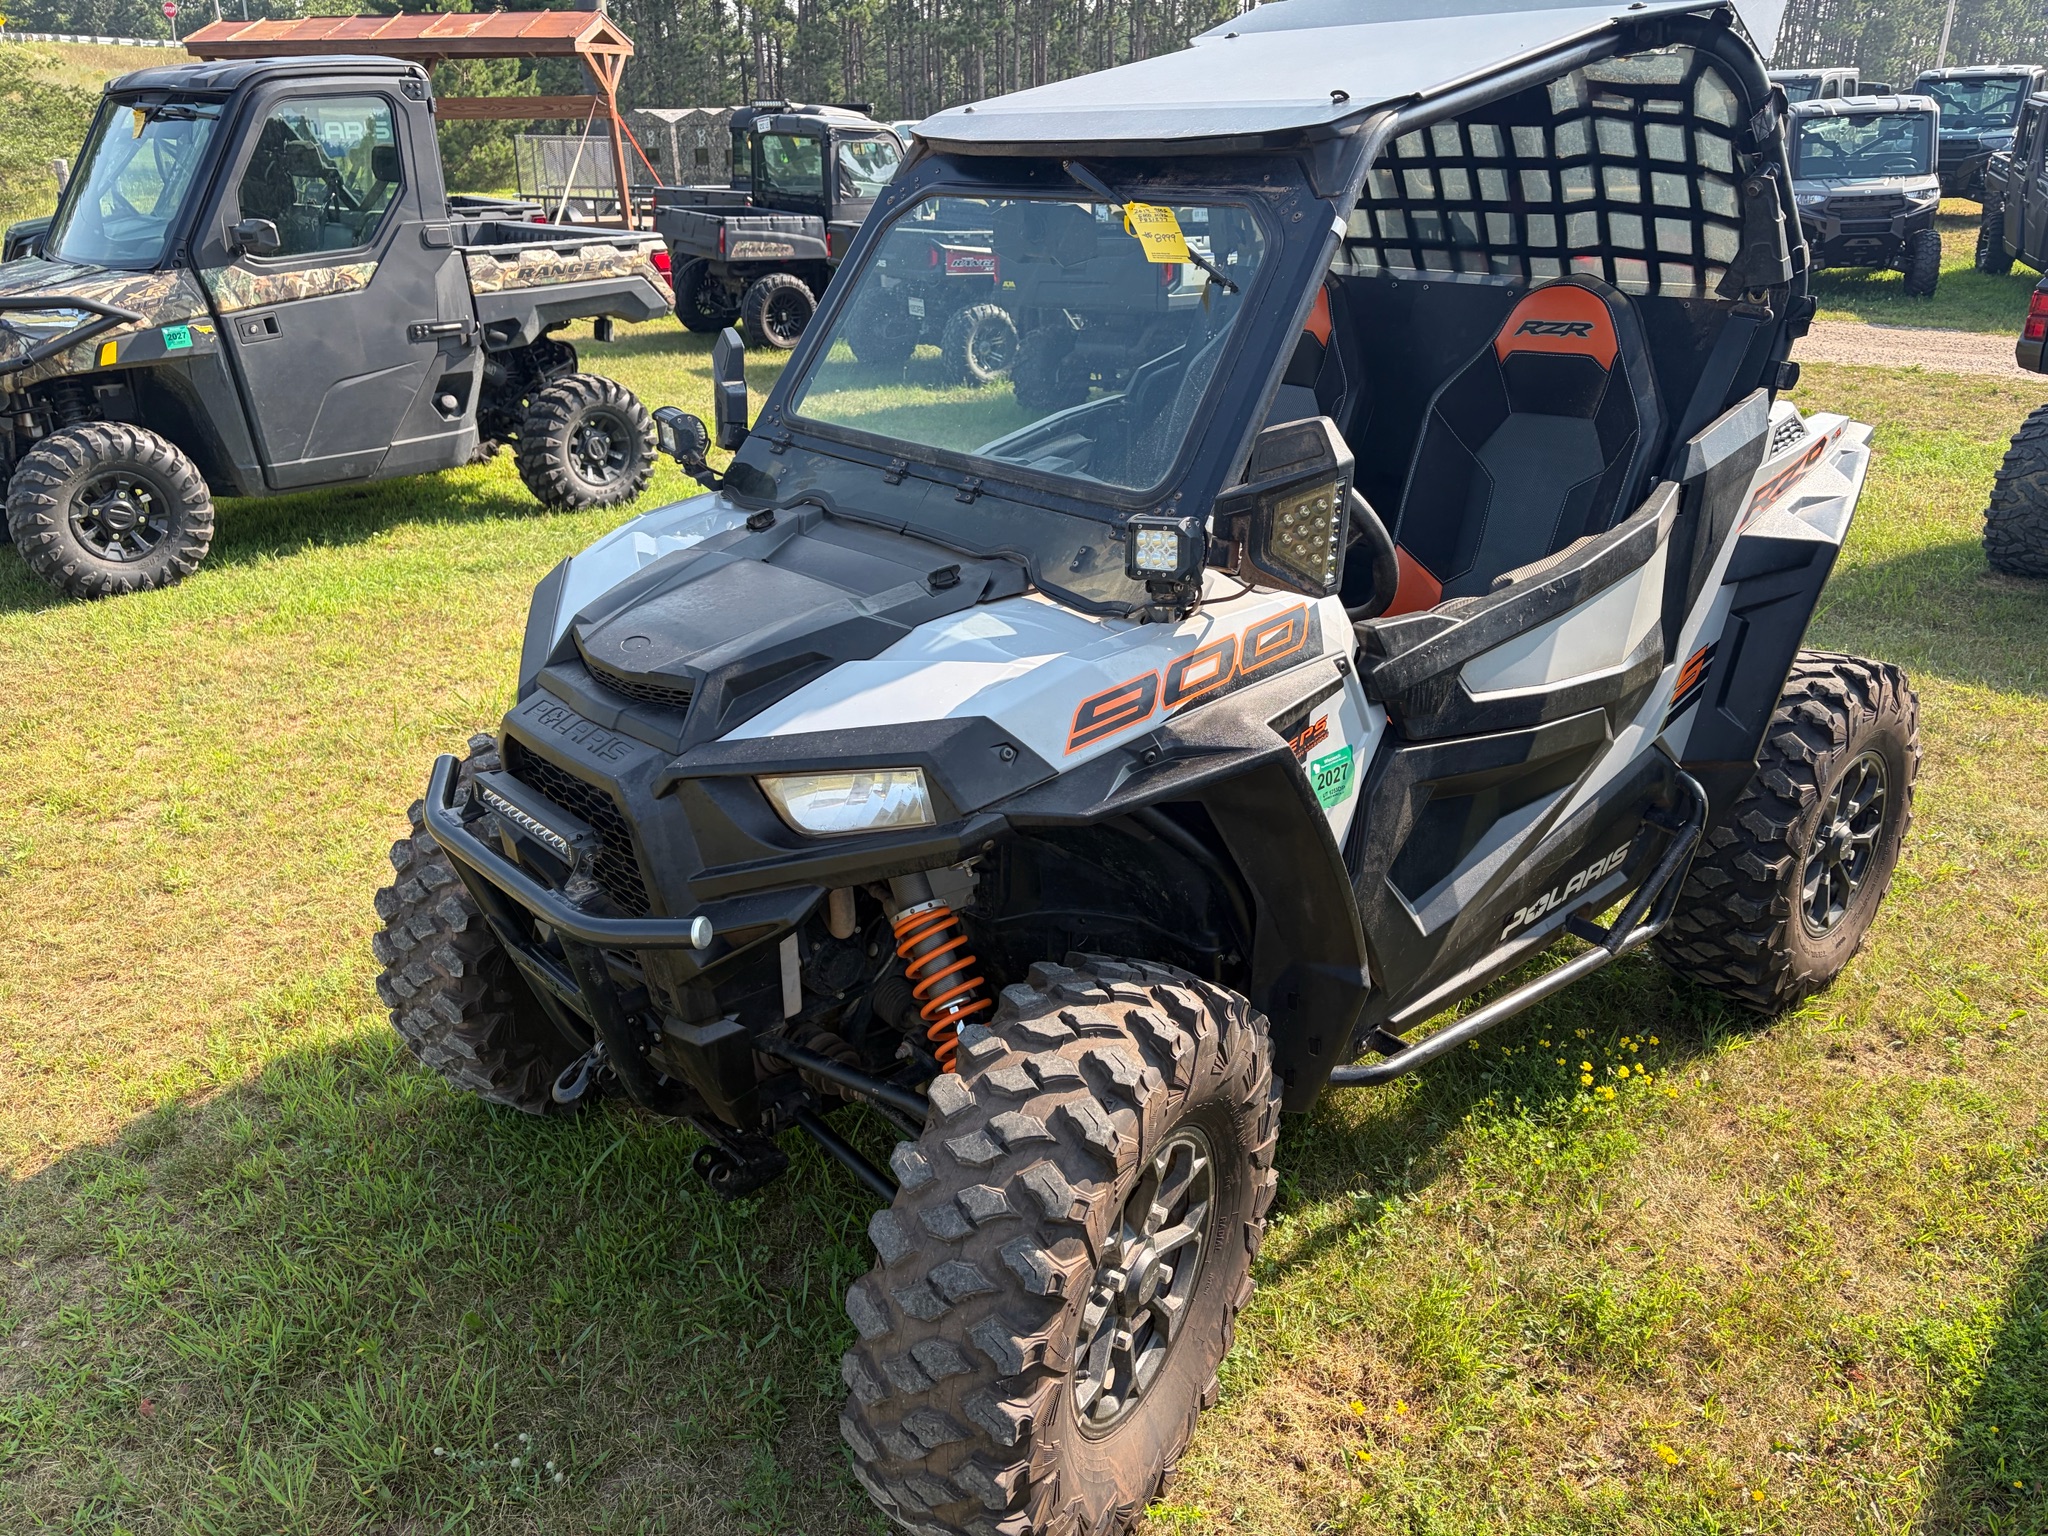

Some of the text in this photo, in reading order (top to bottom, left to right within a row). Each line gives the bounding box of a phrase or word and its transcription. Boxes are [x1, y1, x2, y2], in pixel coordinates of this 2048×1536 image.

[517, 259, 614, 279] RANGER
[167, 332, 186, 341] 2027
[1513, 320, 1595, 338] RZR
[1063, 602, 1310, 757] 900
[523, 700, 635, 764] POLARIS
[1288, 714, 1329, 752] EPS
[1317, 763, 1348, 791] 2027
[1500, 840, 1632, 941] POLARIS
